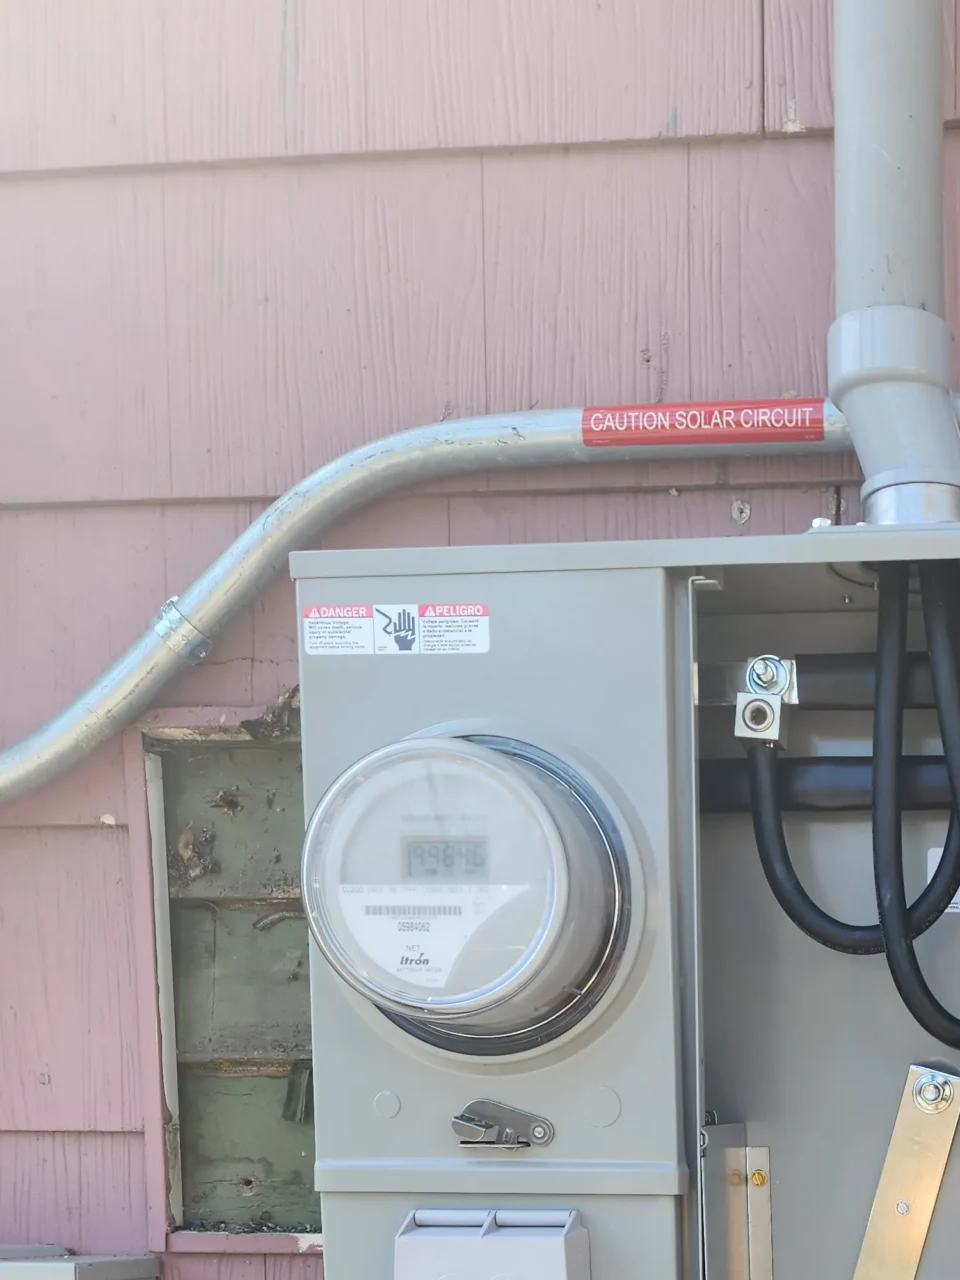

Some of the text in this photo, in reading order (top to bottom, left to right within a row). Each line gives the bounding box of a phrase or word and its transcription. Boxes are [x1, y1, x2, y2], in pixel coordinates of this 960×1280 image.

[590, 407, 814, 431] CAUTION SOLAR CIRCUIT
[320, 604, 483, 618] DANGER PELIGRO
